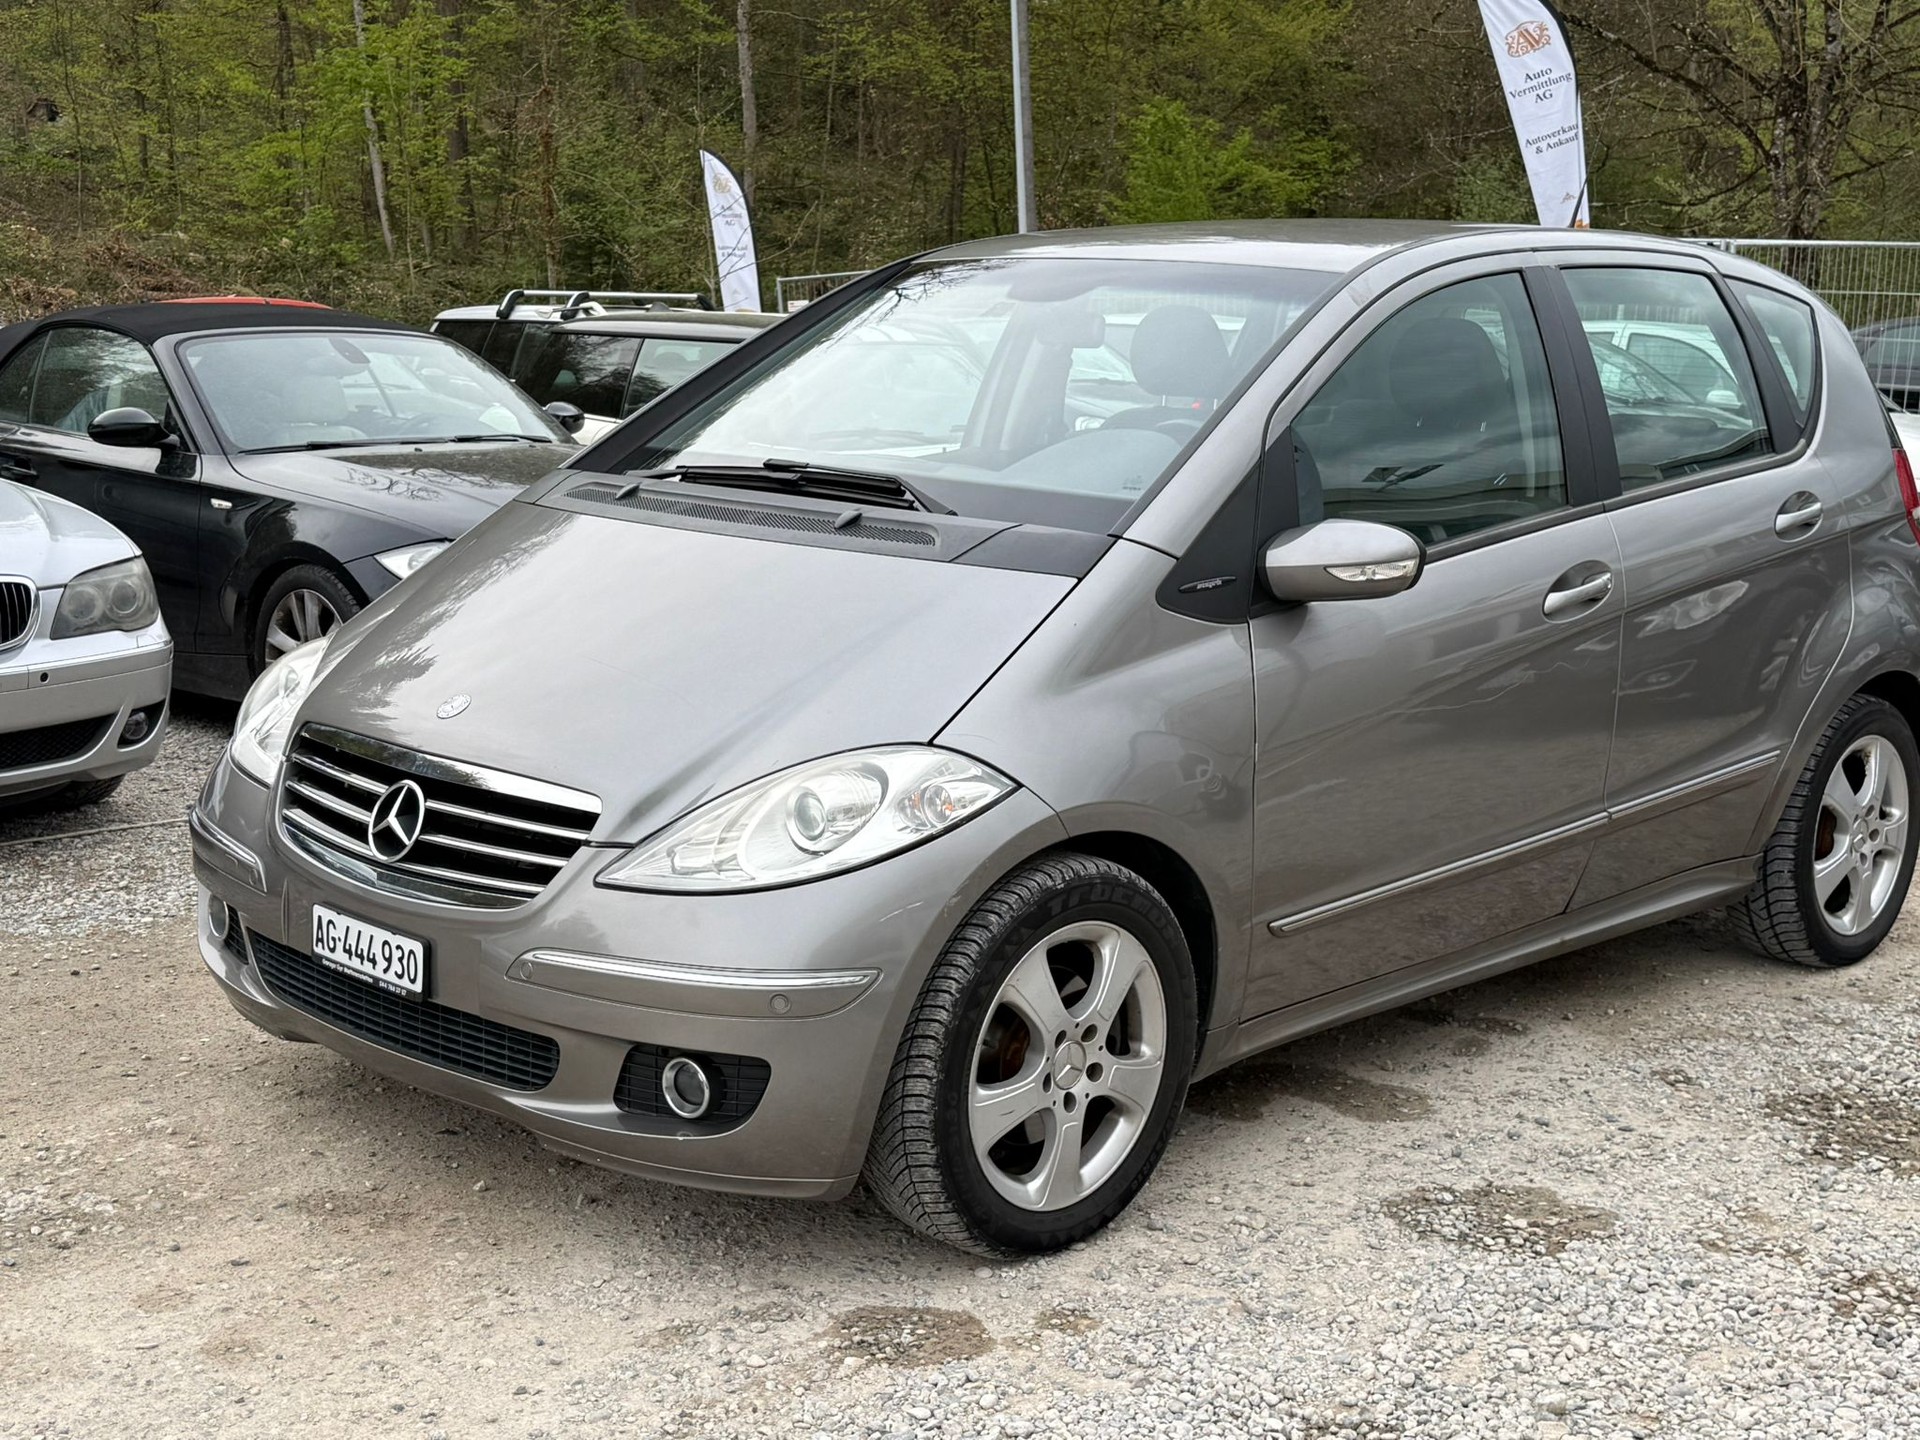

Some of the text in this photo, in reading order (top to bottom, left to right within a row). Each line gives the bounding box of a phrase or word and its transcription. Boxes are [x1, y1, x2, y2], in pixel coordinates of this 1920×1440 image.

[1524, 67, 1553, 83] Auto
[1509, 72, 1573, 99] Vermittlung
[1535, 89, 1553, 103] AG
[1535, 146, 1543, 154] &
